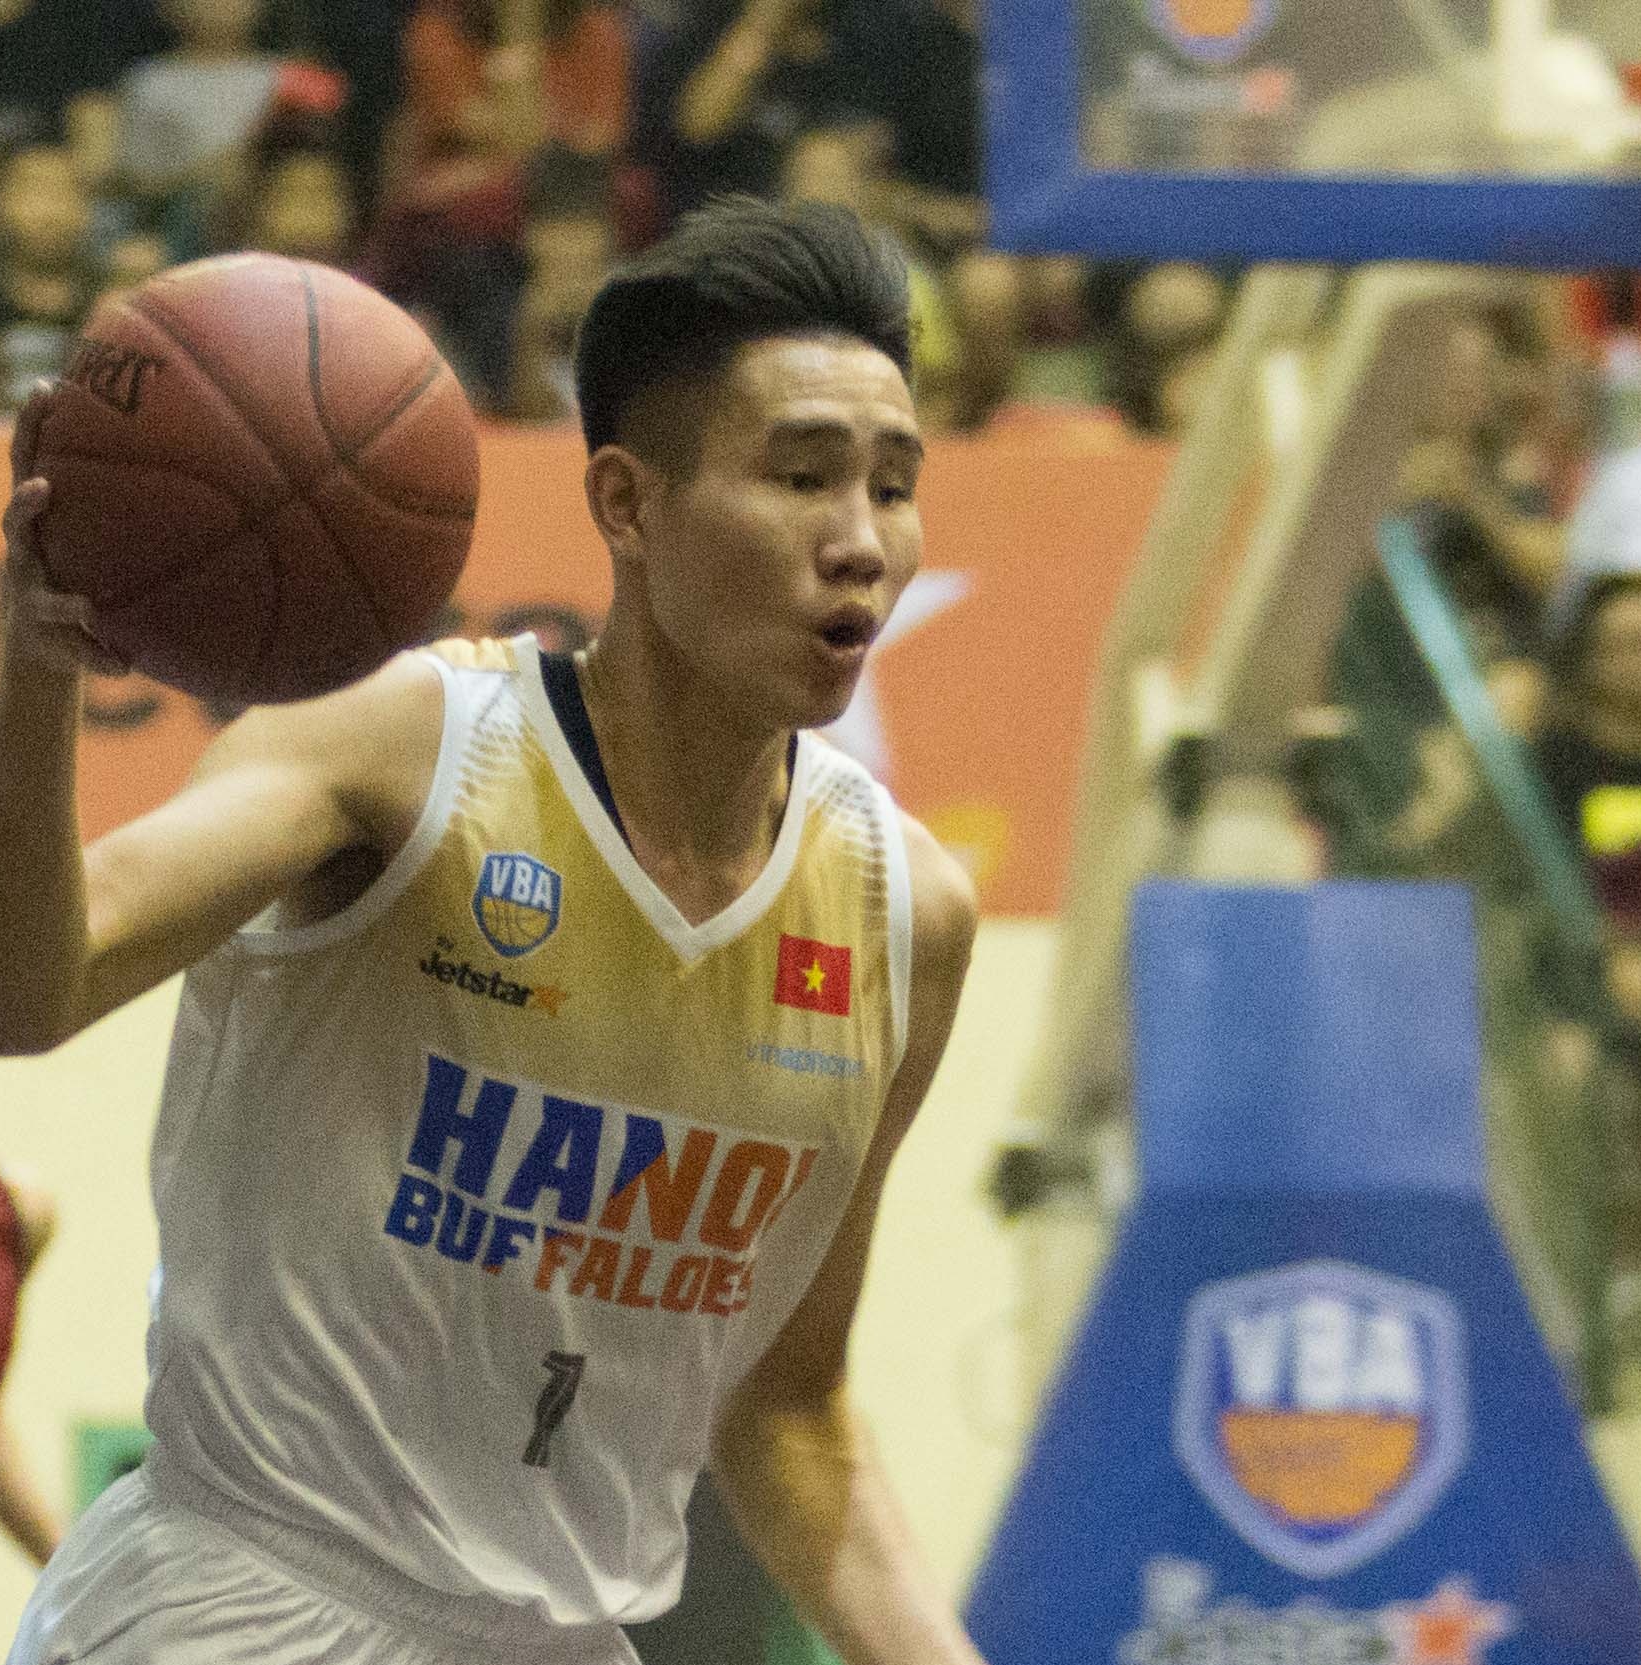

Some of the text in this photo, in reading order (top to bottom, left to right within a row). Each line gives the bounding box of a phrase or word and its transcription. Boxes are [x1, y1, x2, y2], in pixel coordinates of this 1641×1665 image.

[489, 856, 554, 912] VBA
[419, 951, 534, 1007] Jetstar
[1222, 1298, 1422, 1408] VBA
